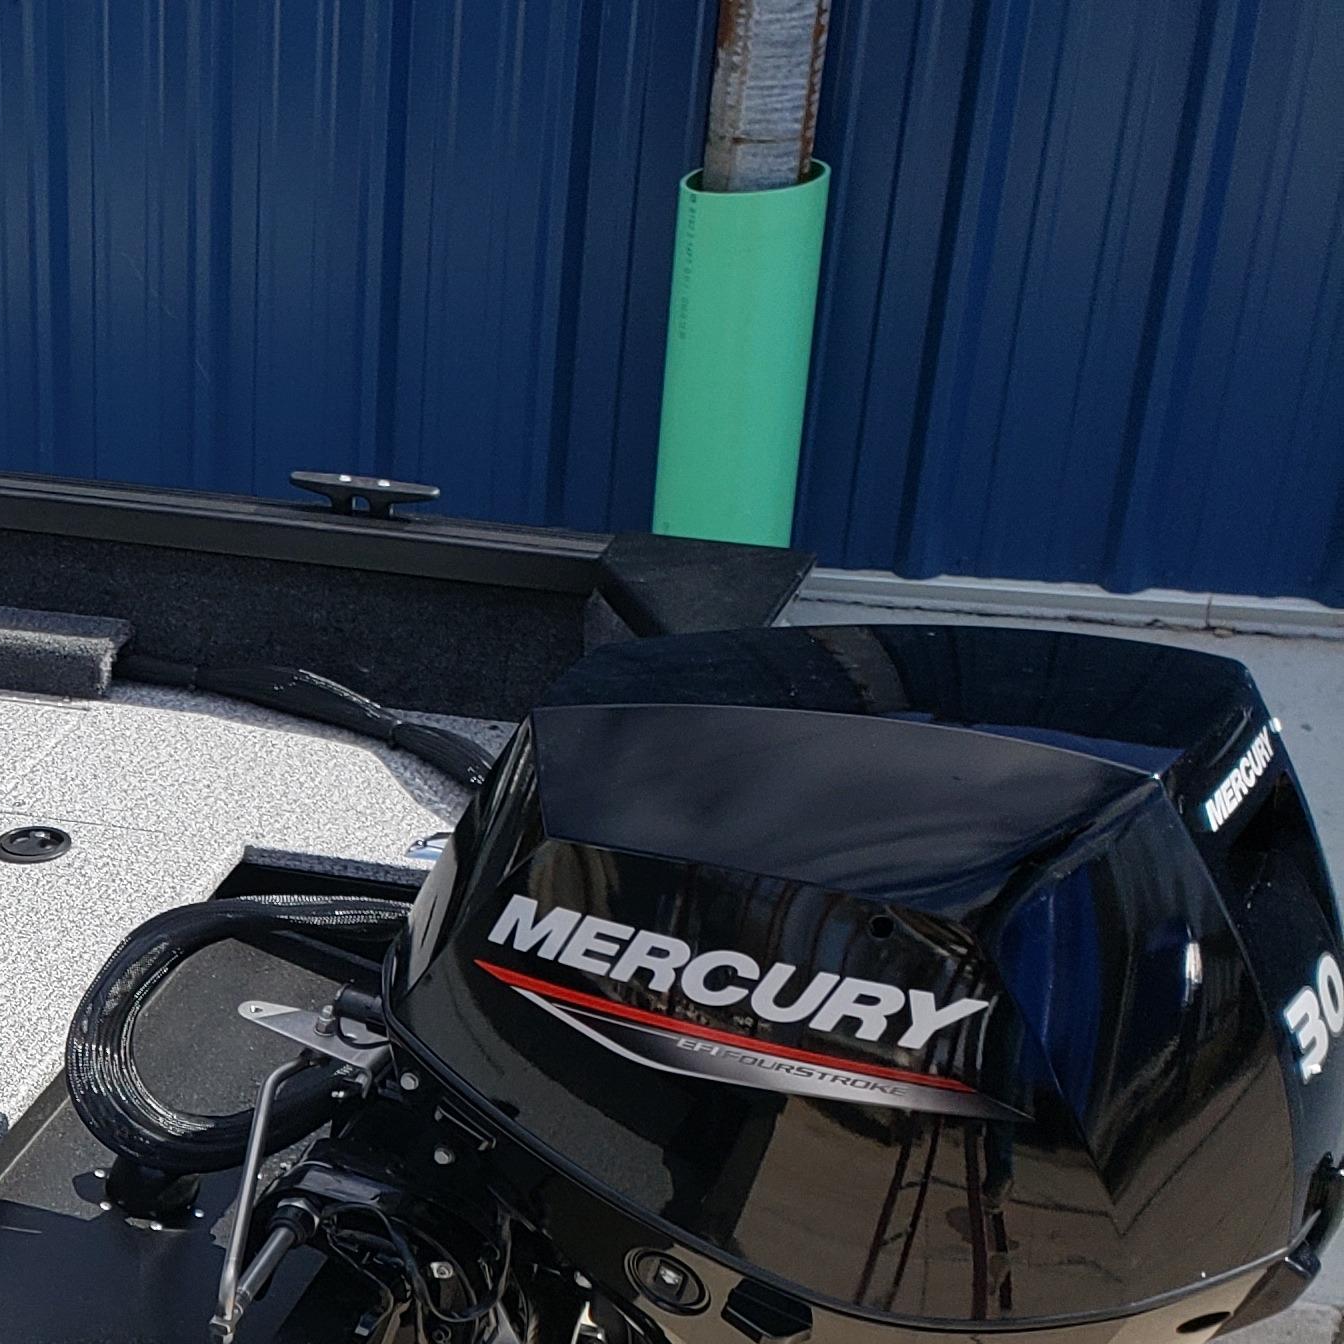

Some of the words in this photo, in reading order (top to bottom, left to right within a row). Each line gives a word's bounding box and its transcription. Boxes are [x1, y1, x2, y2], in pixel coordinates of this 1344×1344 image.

[1204, 726, 1275, 833] MERCURY
[487, 894, 990, 1050] MERCURY
[1283, 951, 1344, 1085] 30
[714, 1048, 911, 1097] FOURSTROKE
